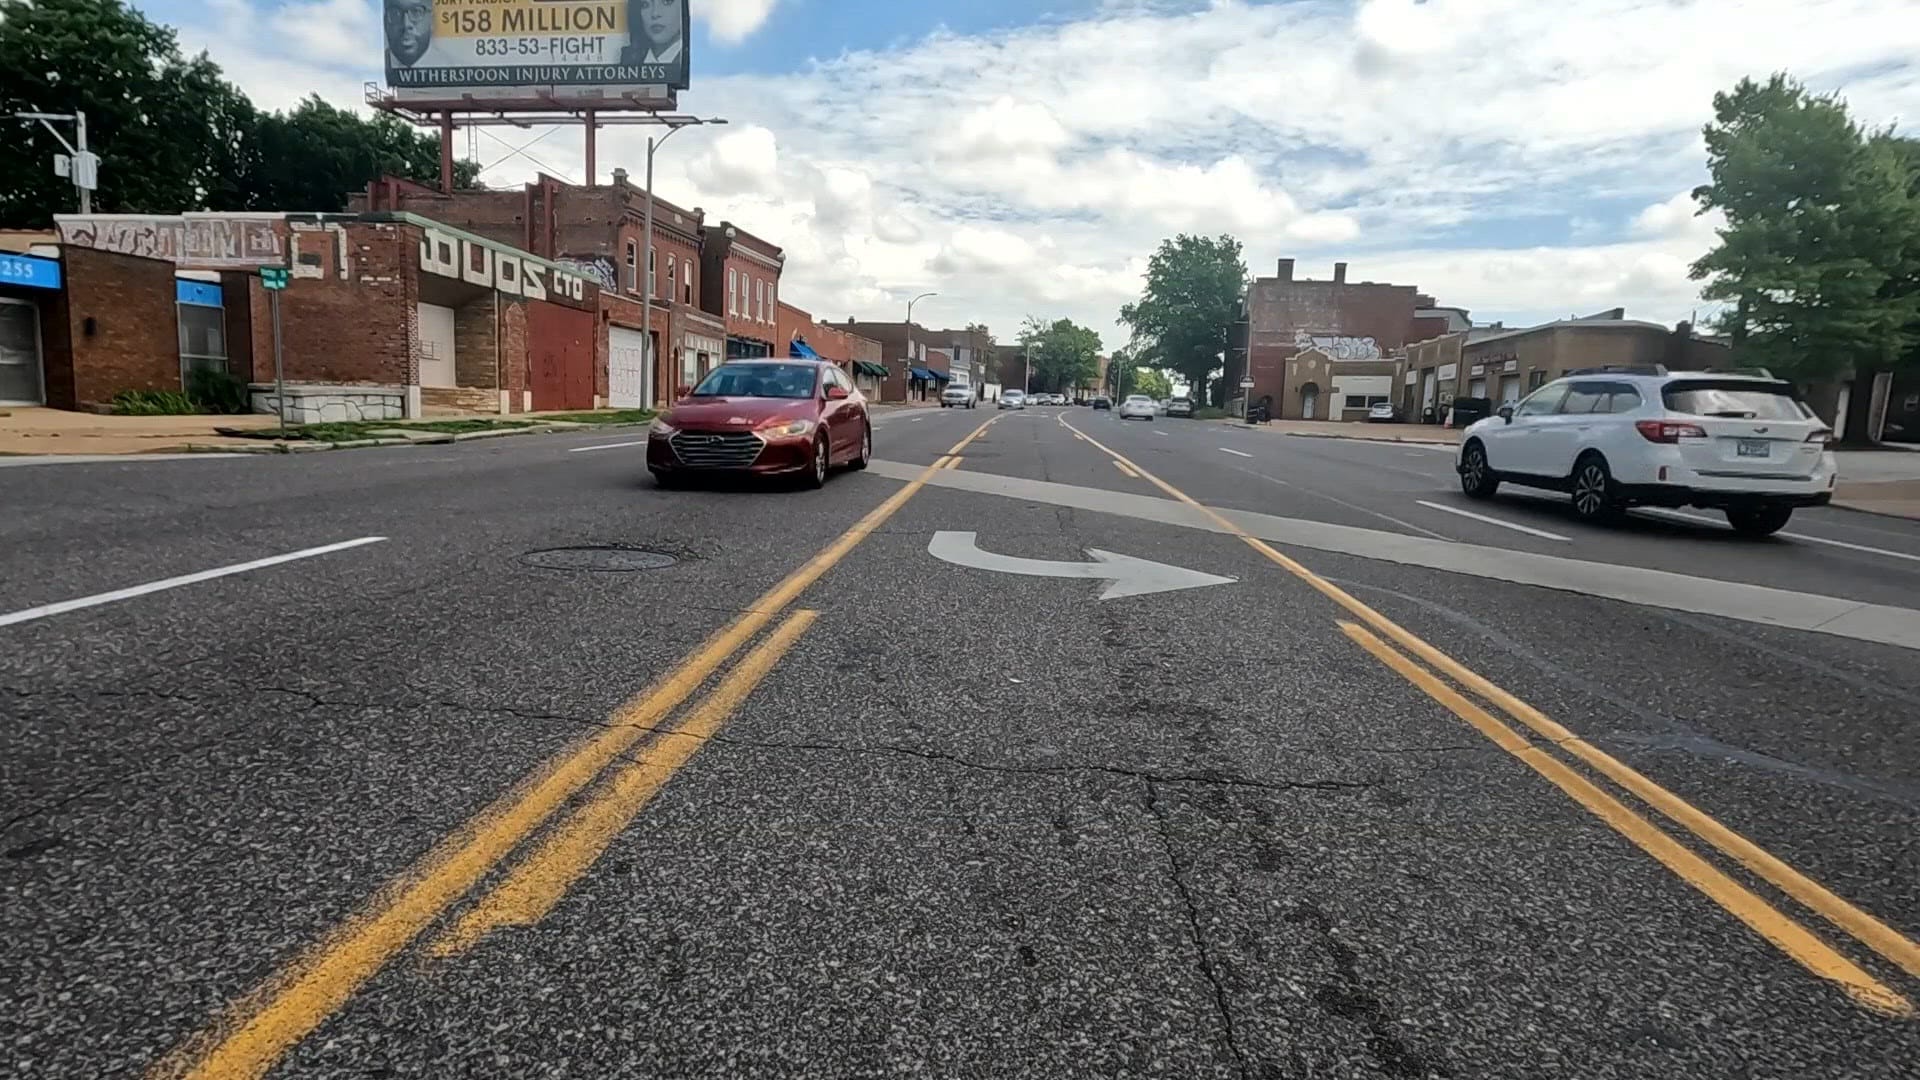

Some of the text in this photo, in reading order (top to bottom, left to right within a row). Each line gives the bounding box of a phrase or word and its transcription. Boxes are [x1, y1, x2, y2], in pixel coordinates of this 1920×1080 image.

[441, 6, 616, 34] $158 MILLION
[475, 36, 606, 56] 833-53-FIGHT
[399, 65, 666, 83] WITHERSPOON INJURY ATTORNEYS
[2, 261, 34, 279] 255
